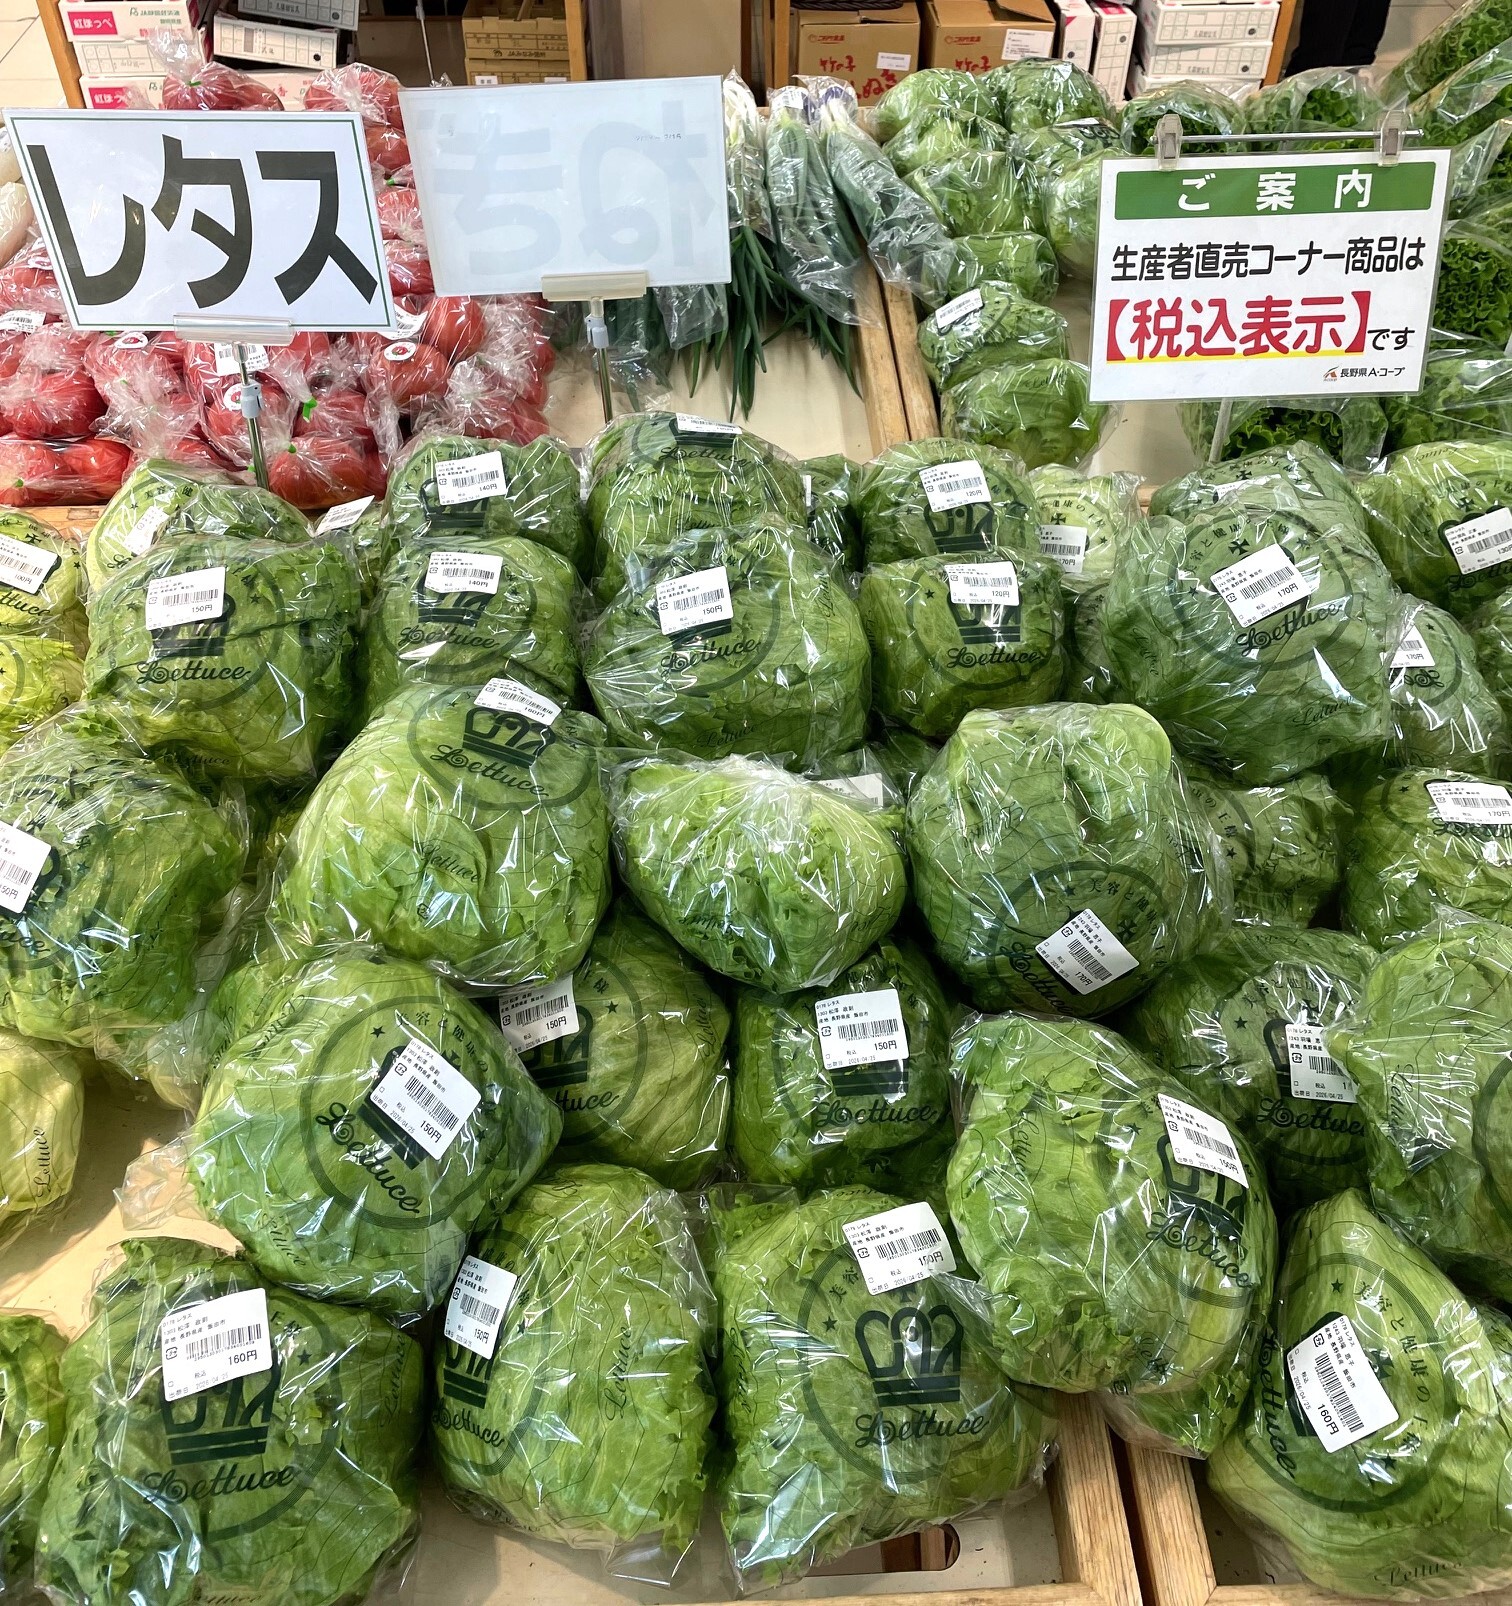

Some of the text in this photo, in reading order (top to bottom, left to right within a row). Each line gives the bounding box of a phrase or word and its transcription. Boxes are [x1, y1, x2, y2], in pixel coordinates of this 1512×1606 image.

[73, 17, 113, 29] 紅ほっぺ
[27, 134, 378, 308] レタス
[1111, 236, 1426, 281] 生産者直売コーナー商品は
[479, 483, 497, 491] 140円
[965, 489, 982, 497] 120円
[1276, 582, 1299, 597] 170円
[0, 591, 51, 617] ttuce
[191, 603, 212, 614] 150円
[702, 604, 722, 616] 150円
[1236, 603, 1344, 655] Lettuce
[947, 646, 1042, 668] Lettuce
[136, 659, 251, 684] Lettuce
[430, 744, 549, 797] Lettuce
[0, 883, 19, 900] 50円
[1001, 942, 1075, 1018] Lettuce
[1074, 970, 1093, 986] 170円
[545, 1015, 566, 1030] 150円
[420, 1047, 434, 1061] レタス
[874, 1040, 897, 1051] 150円
[555, 1090, 619, 1113] ttuce
[1315, 1091, 1343, 1099] 2026/04/25
[389, 1109, 415, 1134] 2026/04/25
[395, 1101, 442, 1143] 税込 150円
[815, 1099, 937, 1128] Lettuce
[316, 1102, 421, 1214] Lettuce
[1218, 1157, 1239, 1174] 150円
[855, 1221, 870, 1229] レタス
[176, 1312, 192, 1322] レタス
[1330, 1321, 1340, 1336] 1243
[473, 1327, 490, 1344] 150円
[1338, 1316, 1356, 1347] 0178 レタス
[1323, 1326, 1333, 1340] 産地
[1329, 1341, 1344, 1365] 長野県産
[194, 1370, 206, 1379] 税込
[228, 1348, 257, 1367] 160円
[604, 1326, 633, 1420] Lettuce
[1256, 1331, 1296, 1479] Lettuce
[1293, 1375, 1312, 1410] 2026/04/25
[1300, 1371, 1339, 1436] 税込 160円
[431, 1398, 504, 1447] Lettuce
[855, 1410, 989, 1448] Lettuce
[143, 1463, 300, 1504] Lettuce
